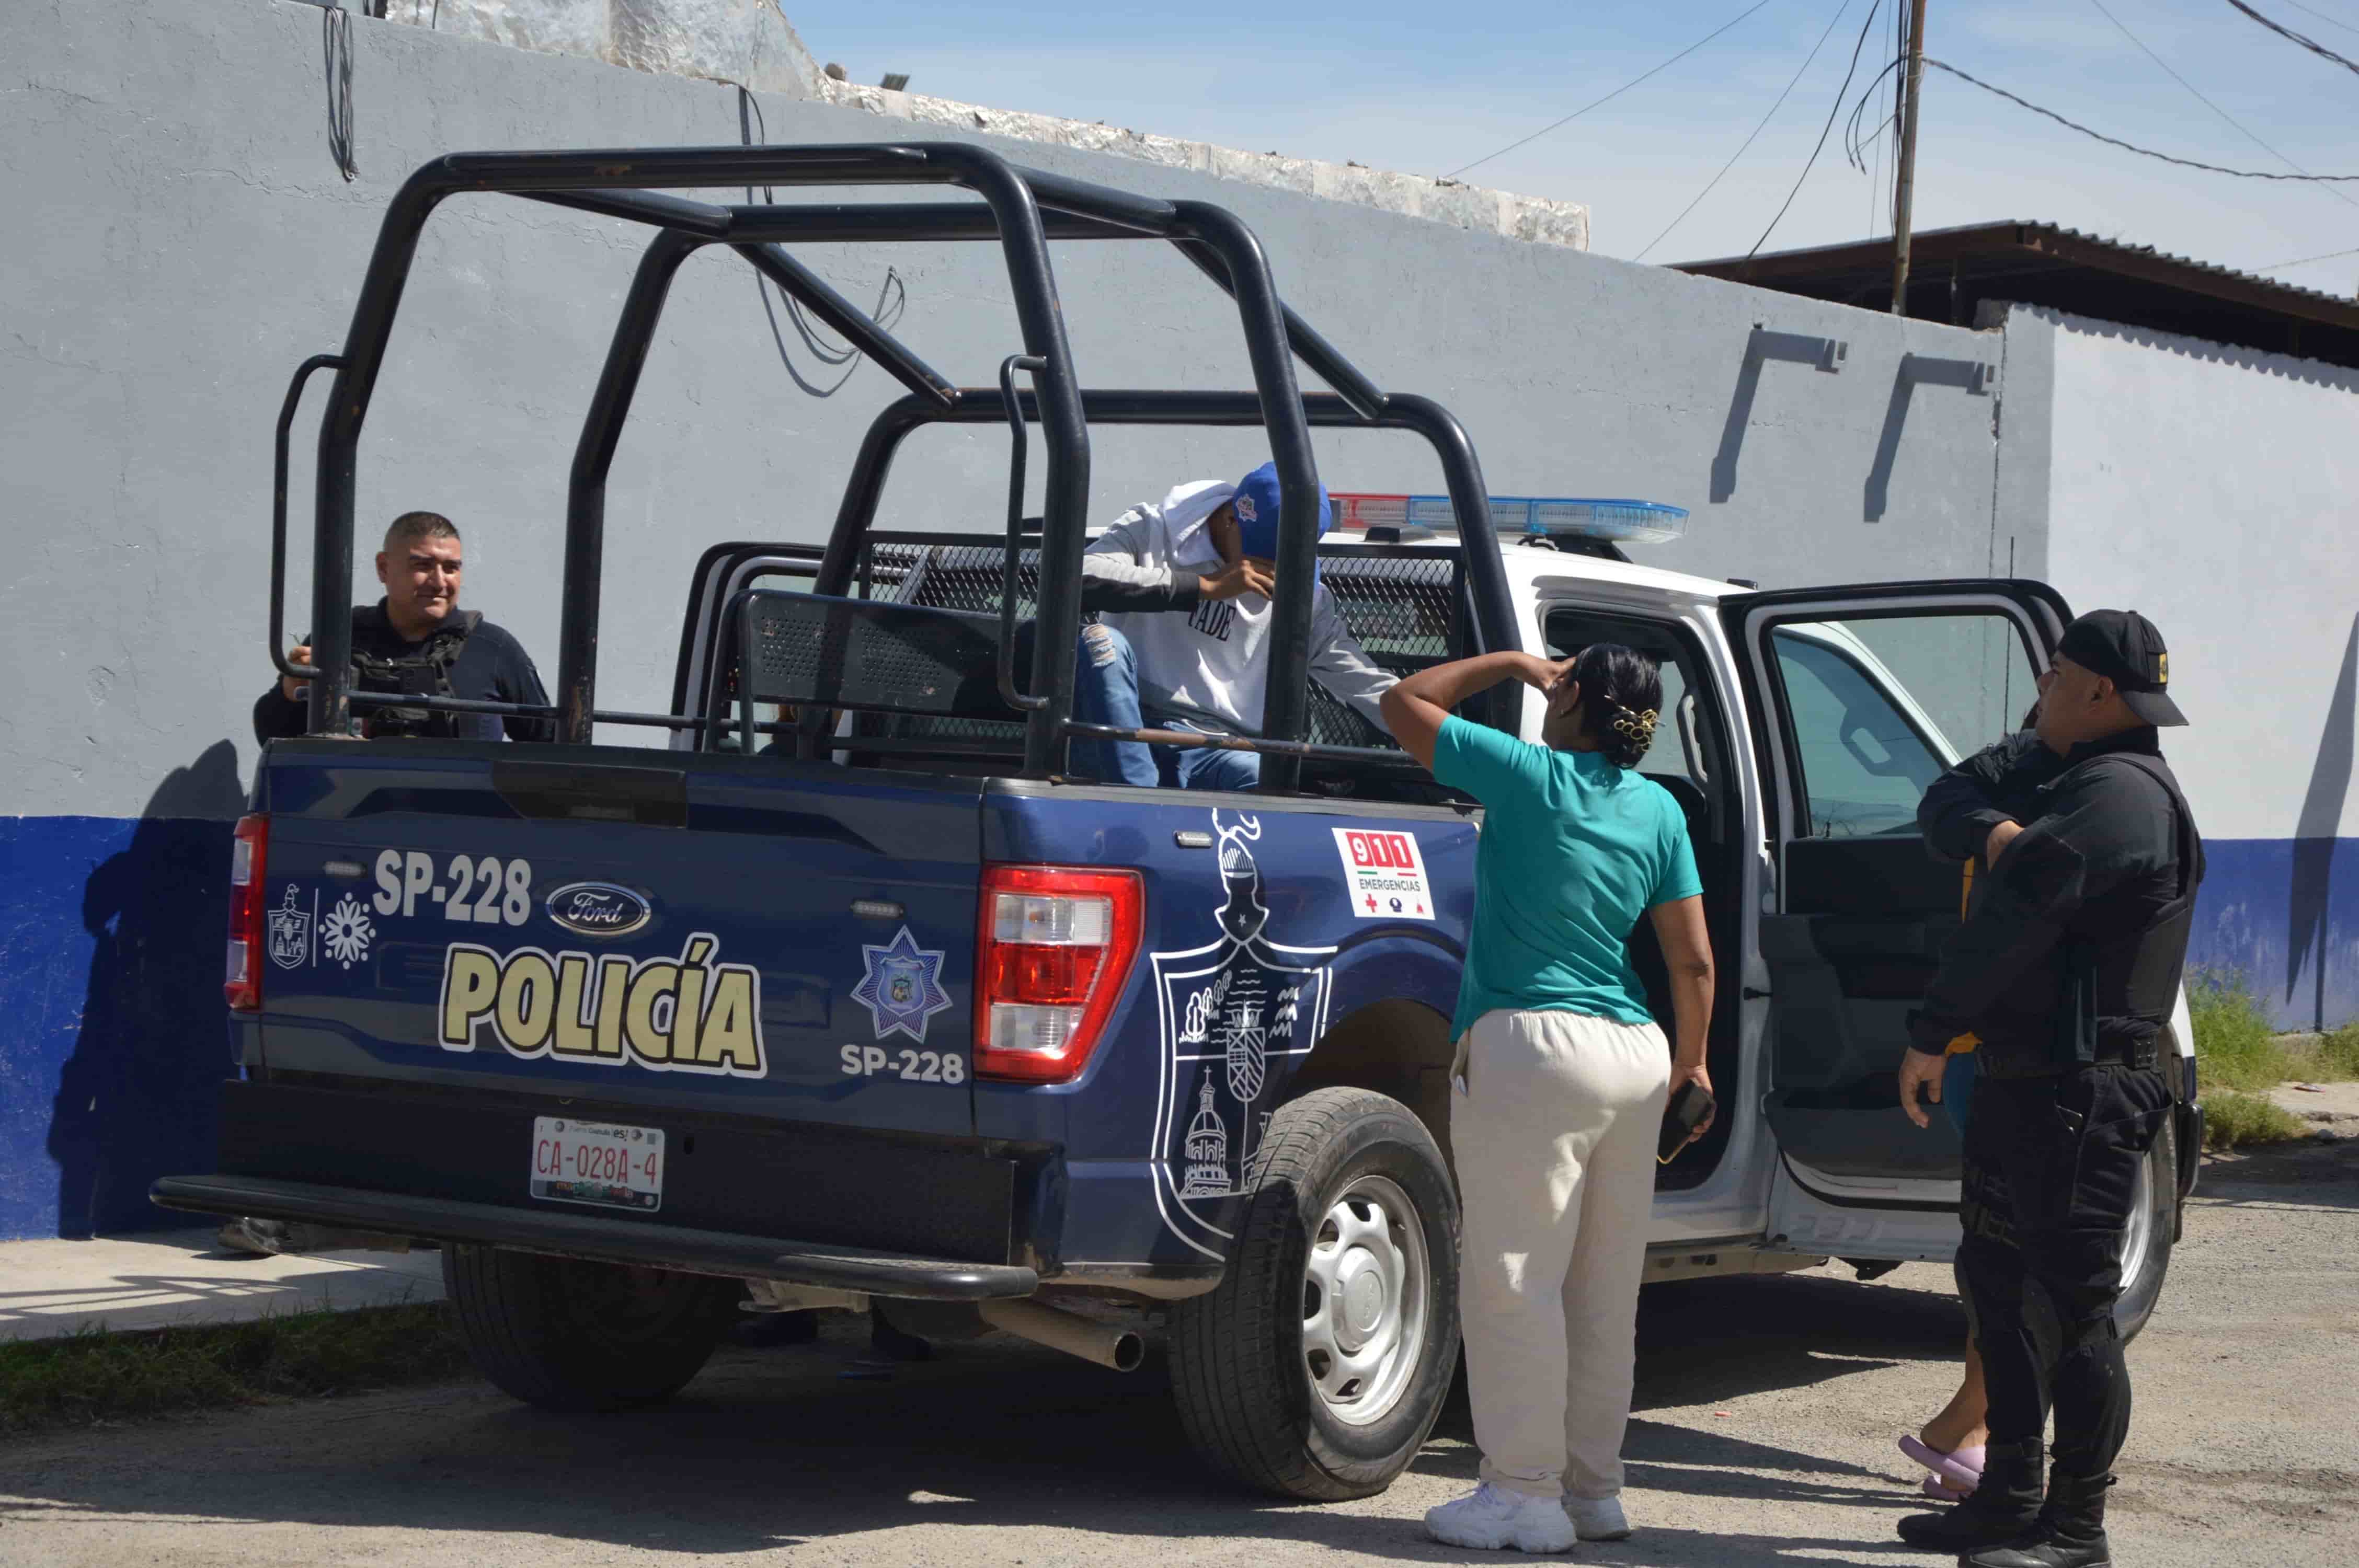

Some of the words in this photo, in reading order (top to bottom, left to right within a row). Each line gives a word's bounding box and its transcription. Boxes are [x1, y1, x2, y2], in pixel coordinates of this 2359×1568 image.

[1351, 836, 1410, 865] 911
[372, 849, 532, 926] SP-228
[1359, 878, 1421, 892] EMERGENCIAS
[567, 892, 624, 924] Ford
[438, 932, 768, 1079] POLICÍA
[840, 1045, 964, 1083] SP-228
[537, 1139, 657, 1186] CA-028A-4
